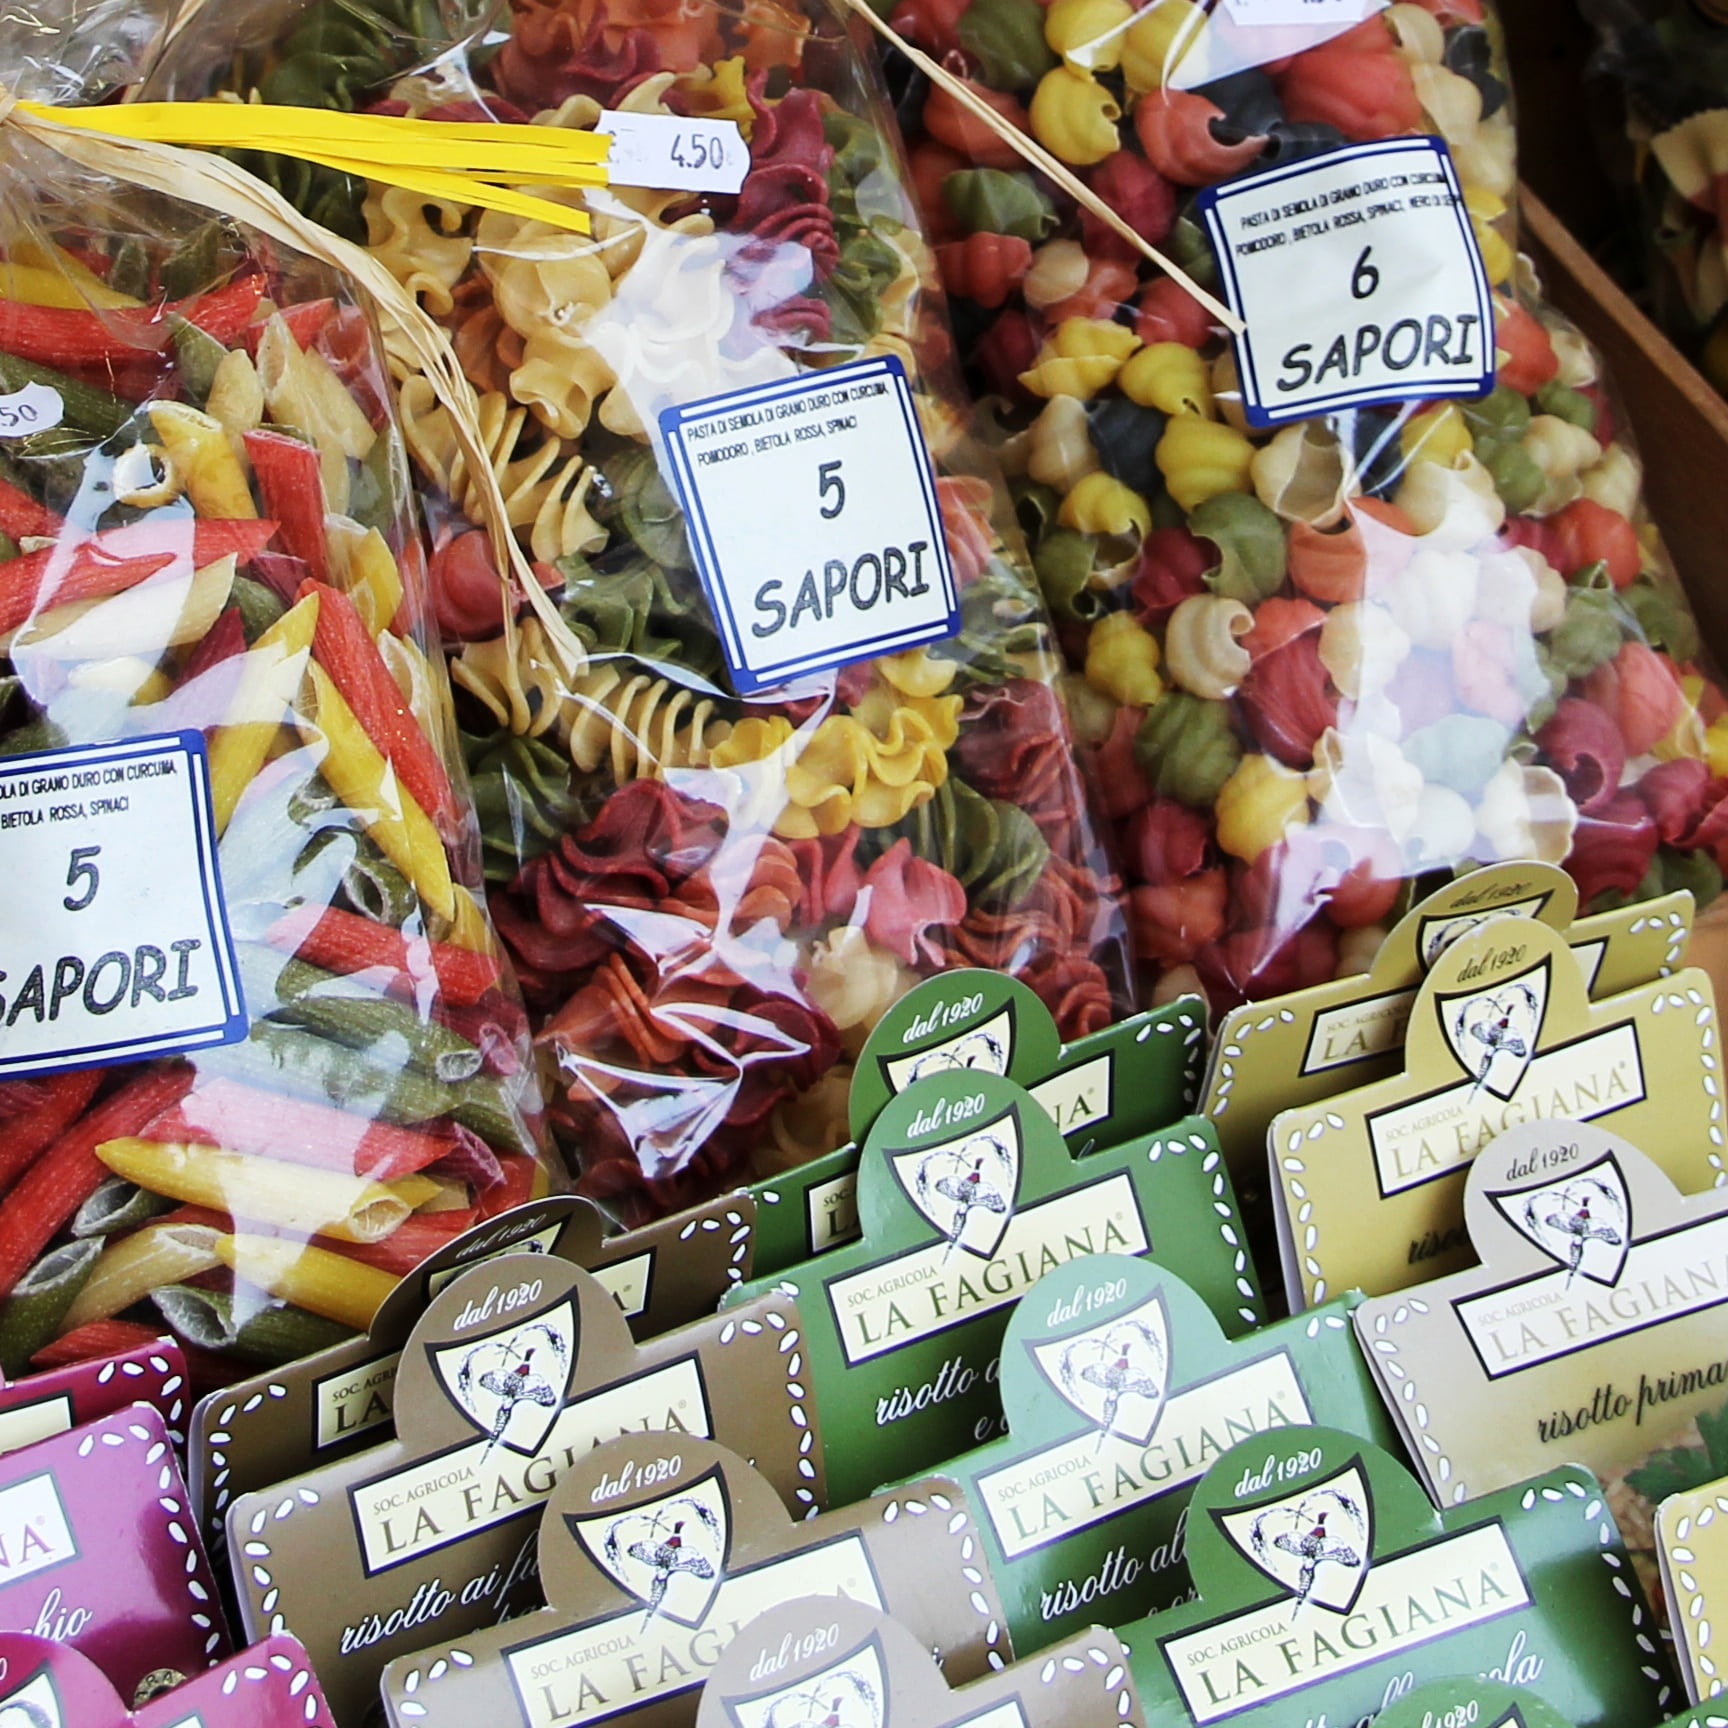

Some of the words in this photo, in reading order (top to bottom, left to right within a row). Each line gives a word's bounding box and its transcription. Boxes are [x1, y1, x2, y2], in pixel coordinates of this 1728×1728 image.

[669, 132, 725, 170] 4.50
[1350, 244, 1380, 300] 6
[1276, 313, 1480, 392] SAPORI
[818, 459, 847, 520] 5
[750, 539, 931, 639] SAPORI
[19, 780, 30, 799] DI
[32, 775, 70, 796] GRANO
[72, 770, 102, 790] DURO
[103, 767, 125, 785] CON
[1, 809, 44, 831] BIETOLA
[89, 796, 130, 817] SPINACI
[63, 845, 103, 913] 5
[901, 1001, 942, 1044] dal
[941, 992, 985, 1028] 1920
[906, 1102, 945, 1138] dal
[943, 1092, 986, 1125] 1920
[1505, 1154, 1540, 1183] dal
[1539, 1143, 1580, 1171] 1920
[453, 1292, 495, 1332] dal
[495, 1278, 545, 1314] 1920
[847, 1289, 877, 1308] SOC.
[877, 1265, 938, 1297] AGRICOLA
[855, 1302, 912, 1347] LA
[924, 1216, 1132, 1319] FAGIANA
[1046, 1284, 1084, 1328] dal
[1083, 1276, 1127, 1312] 1920
[1486, 1317, 1551, 1363] LA
[874, 1355, 978, 1425] risotto
[1537, 1370, 1633, 1444] risotto
[372, 1492, 405, 1516] SOC.
[407, 1465, 475, 1502] AGRICOLA
[589, 1469, 635, 1505] dal
[634, 1453, 683, 1490] 1920
[1233, 1454, 1274, 1499] dal
[1273, 1446, 1323, 1485] 1920
[1039, 1543, 1143, 1622] risotto
[339, 1574, 456, 1654] risotto
[461, 1570, 504, 1602] ai
[1197, 1660, 1266, 1707] LA
[1276, 1567, 1511, 1676] FAGIANA
[1185, 1647, 1217, 1668] SOC.
[1218, 1621, 1289, 1654] AGRICOLA
[540, 1677, 608, 1728] LA
